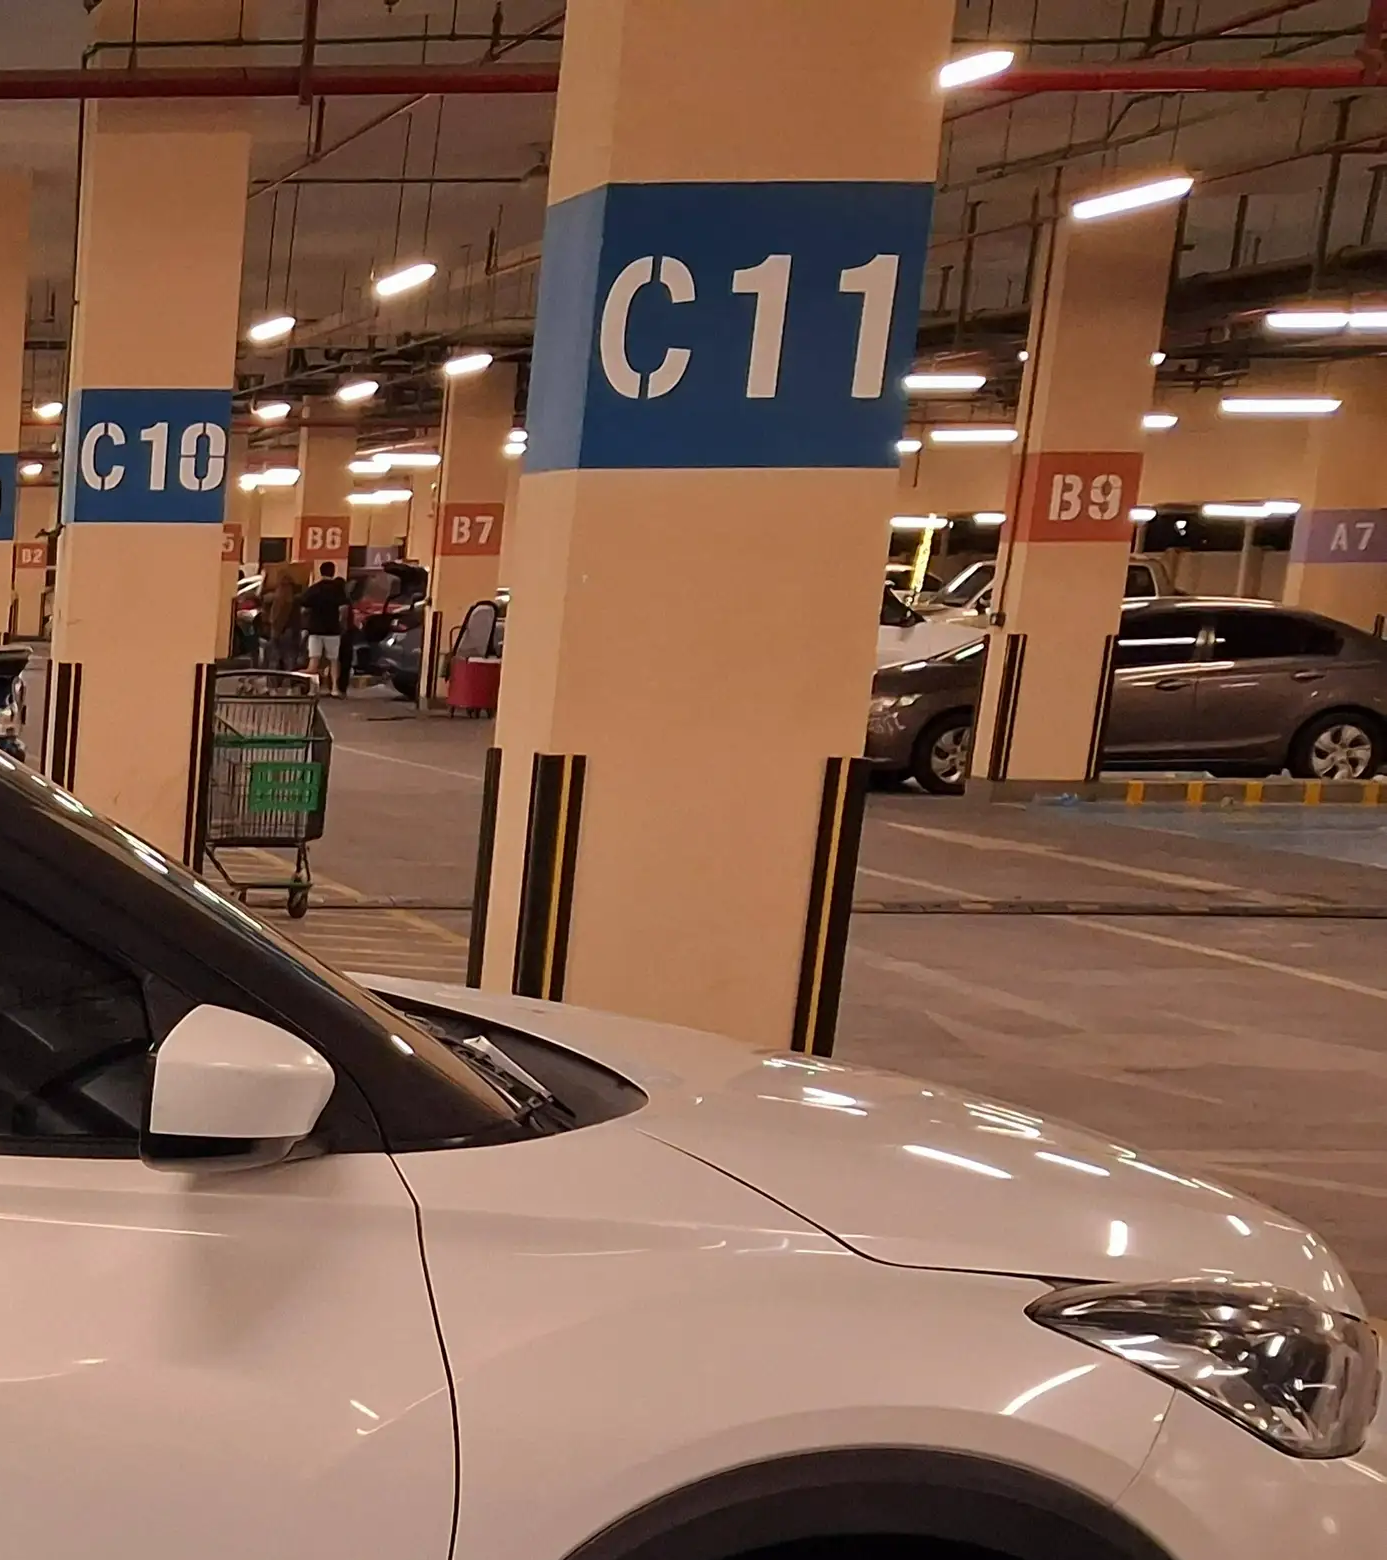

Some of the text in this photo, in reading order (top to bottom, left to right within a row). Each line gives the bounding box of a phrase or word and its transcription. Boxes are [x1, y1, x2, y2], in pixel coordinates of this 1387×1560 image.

[600, 254, 900, 399] C11
[81, 421, 226, 491] C10
[1048, 474, 1123, 520] B9
[307, 526, 342, 550] B6
[451, 515, 494, 545] B7
[1330, 522, 1375, 552] A7
